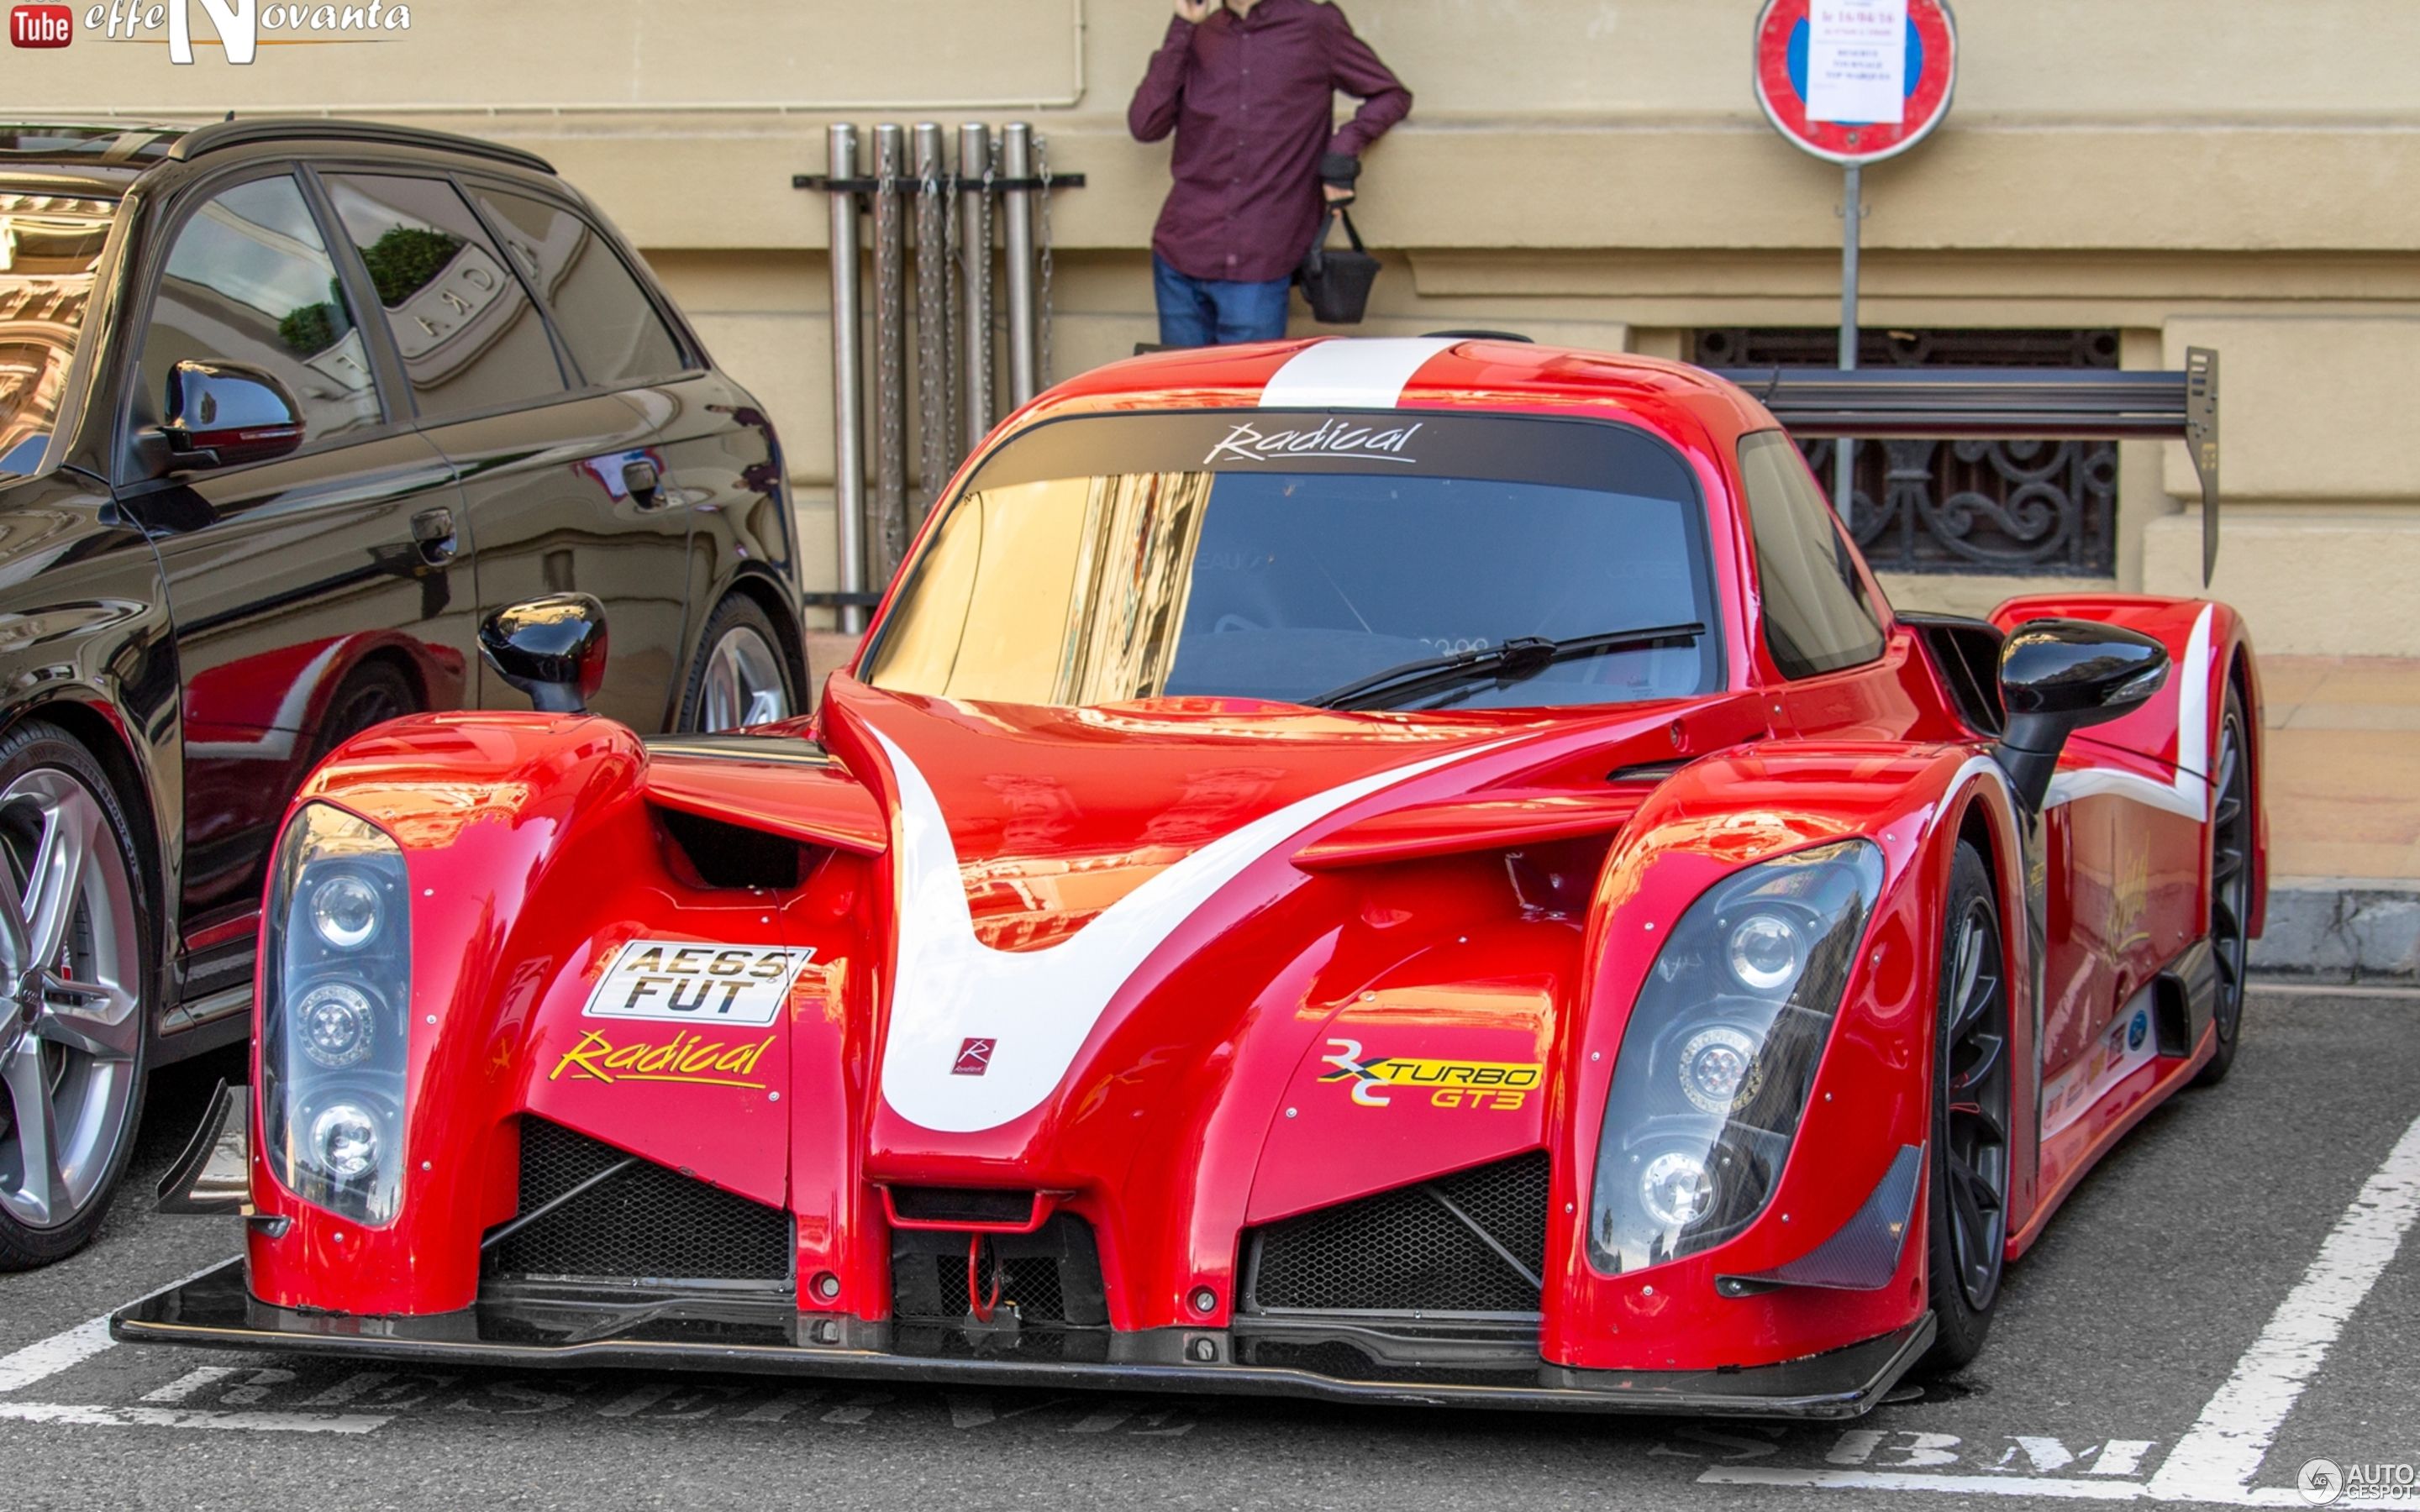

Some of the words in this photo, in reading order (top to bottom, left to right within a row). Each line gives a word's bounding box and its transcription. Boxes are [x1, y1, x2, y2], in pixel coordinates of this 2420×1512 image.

[1203, 418, 1423, 464] Radical
[626, 946, 797, 979] AE65
[624, 976, 755, 1015] FUT
[549, 1029, 777, 1089] Radical
[1386, 1063, 1537, 1086] TURBO
[1430, 1089, 1526, 1110] GT3
